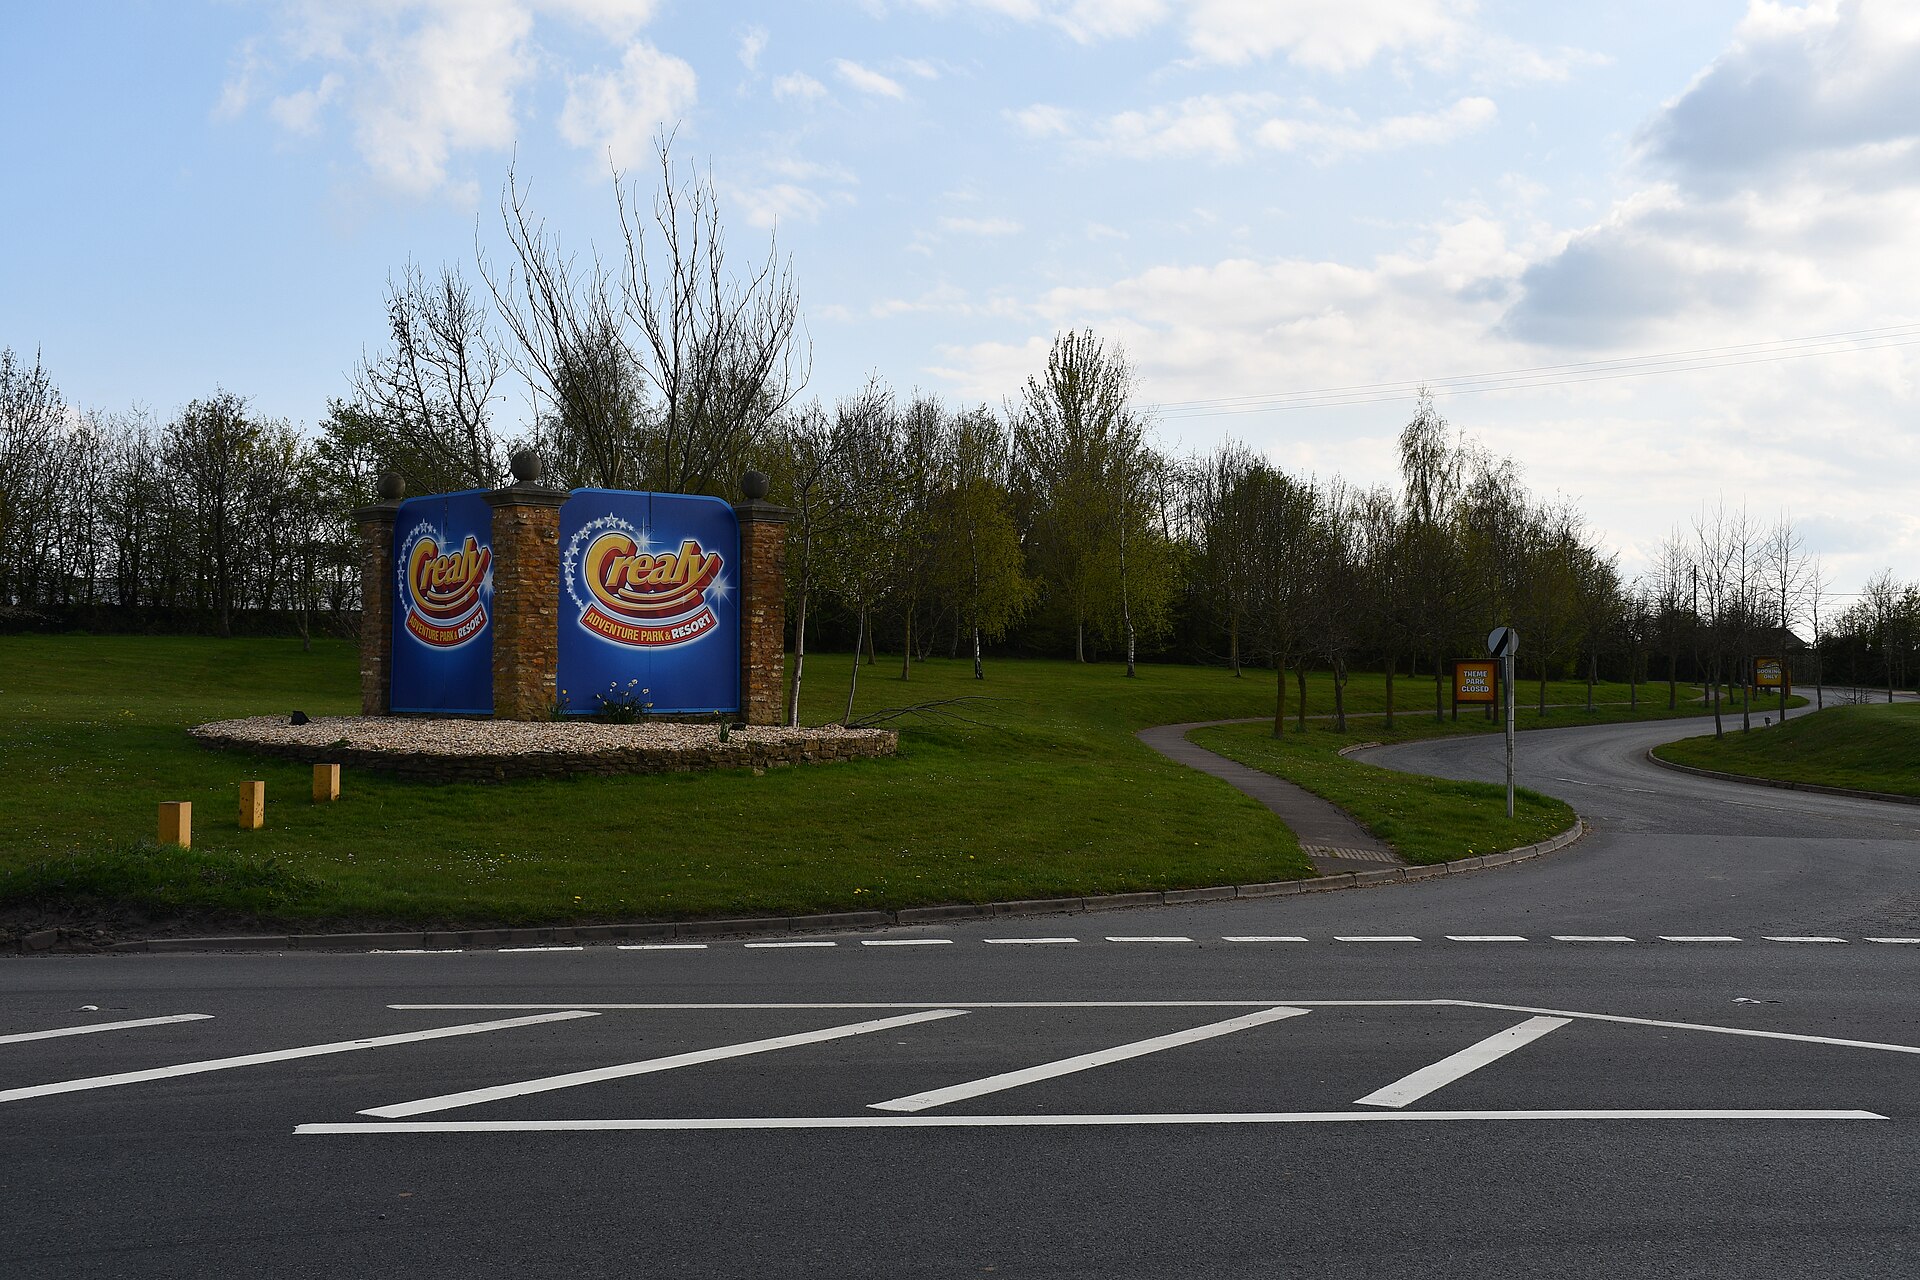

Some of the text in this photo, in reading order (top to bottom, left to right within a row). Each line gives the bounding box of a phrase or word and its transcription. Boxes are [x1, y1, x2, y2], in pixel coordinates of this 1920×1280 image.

[408, 536, 491, 619] Crealy
[585, 532, 723, 619] Crealy
[409, 615, 439, 641] ADVENTURE
[440, 630, 455, 642] PARK
[457, 611, 483, 639] RESORT
[586, 612, 711, 642] ADVENTURE PARK & RESORT
